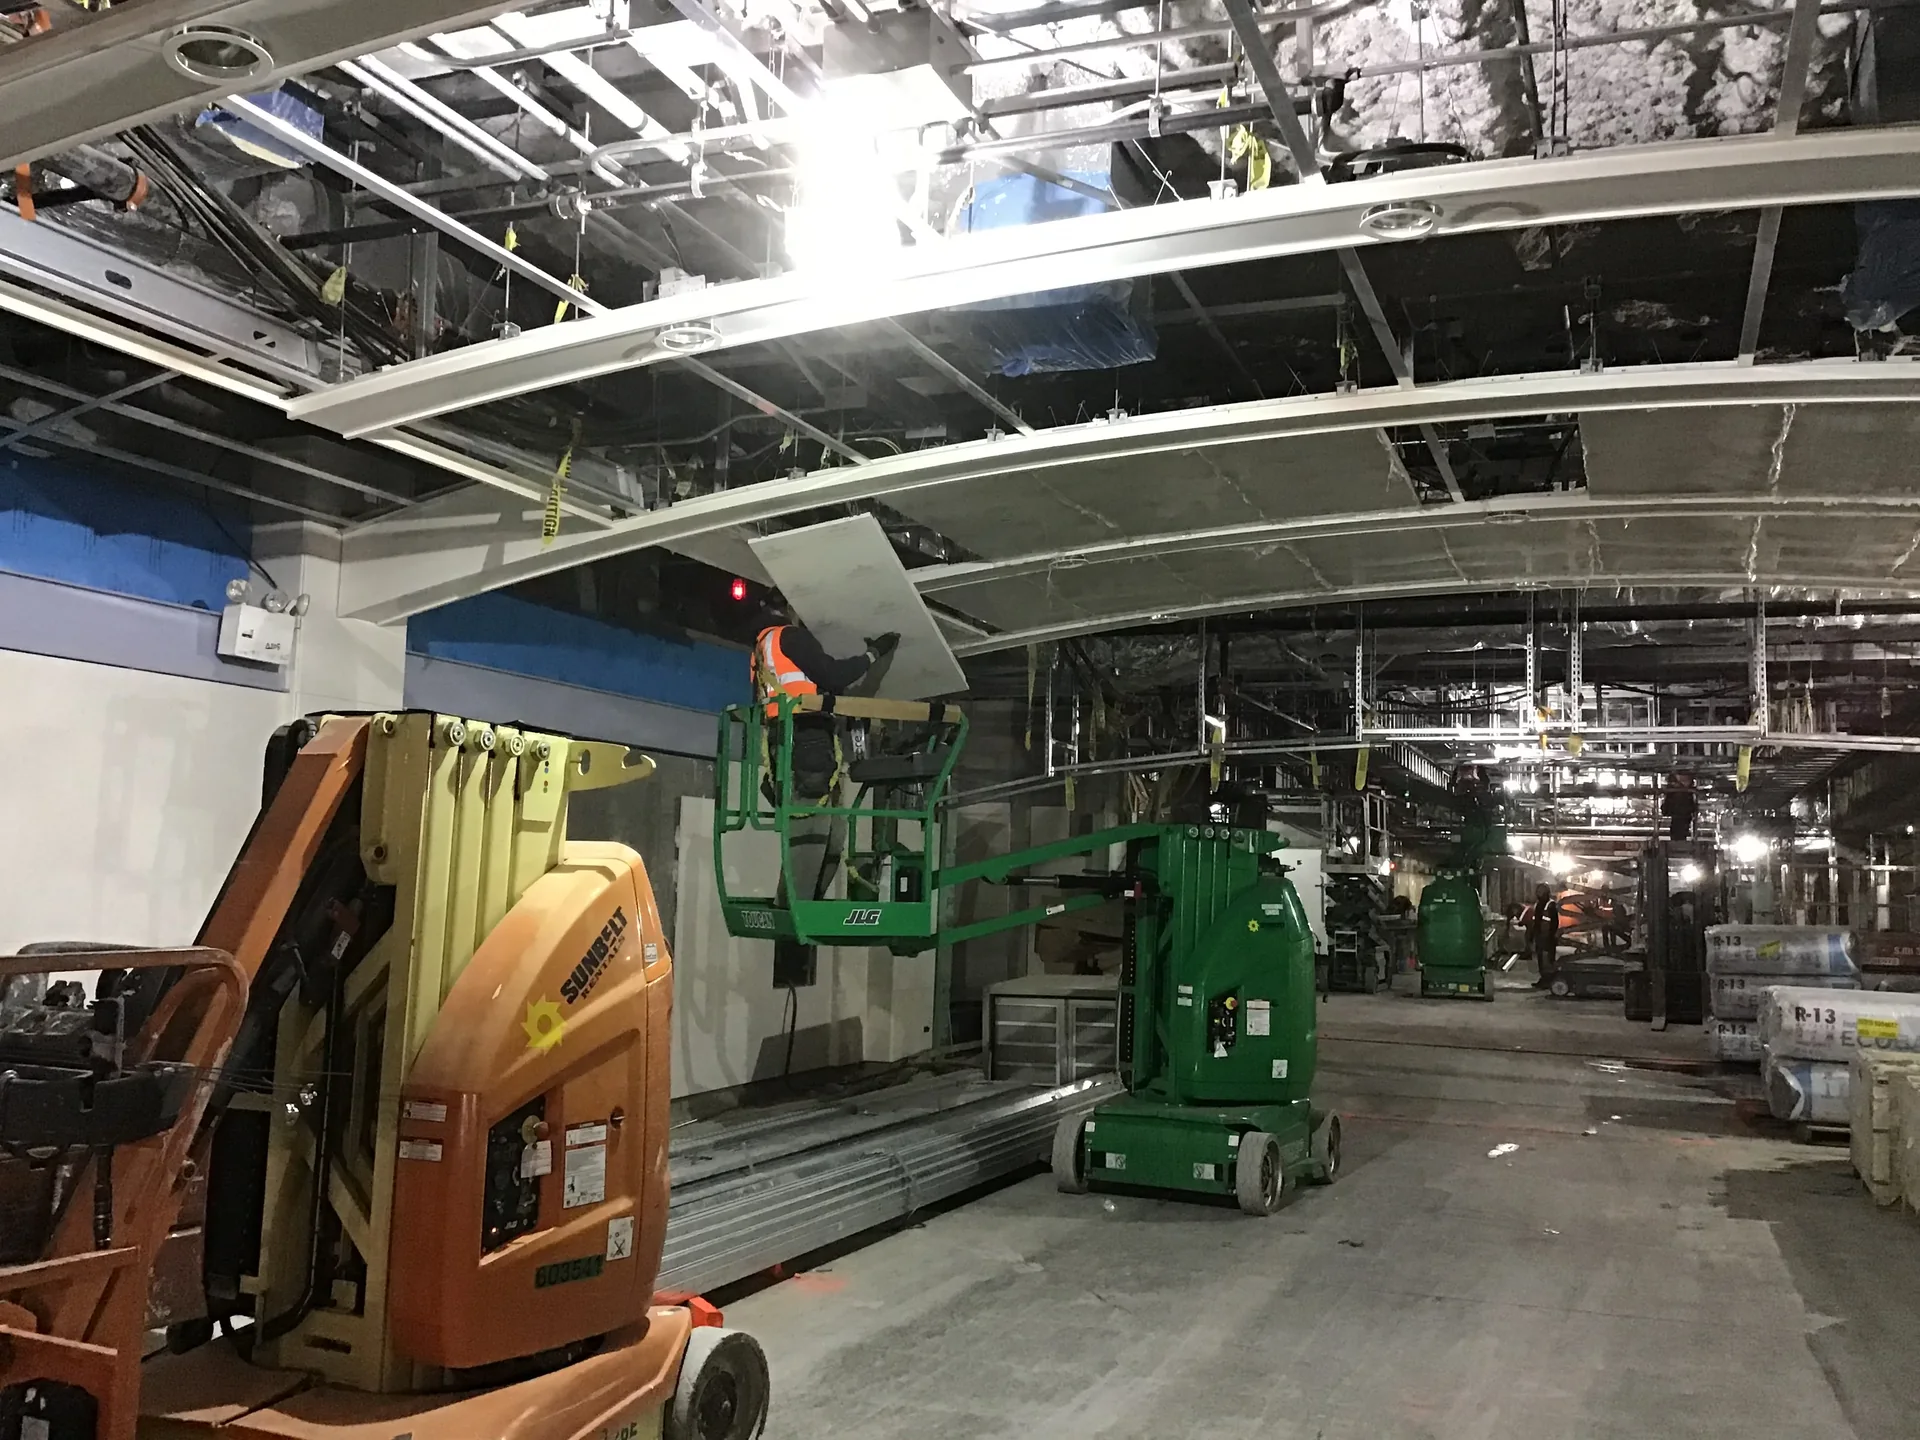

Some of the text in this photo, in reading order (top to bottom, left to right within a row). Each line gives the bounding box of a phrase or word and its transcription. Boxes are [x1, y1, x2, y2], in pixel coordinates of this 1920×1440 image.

[843, 909, 882, 926] JLG
[1713, 935, 1742, 946] R-13
[560, 905, 628, 1005] SUNBELT
[580, 935, 626, 1000] RENTALS
[1717, 979, 1745, 990] R-13
[1794, 1006, 1836, 1024] R-13
[1718, 1024, 1747, 1035] R-13
